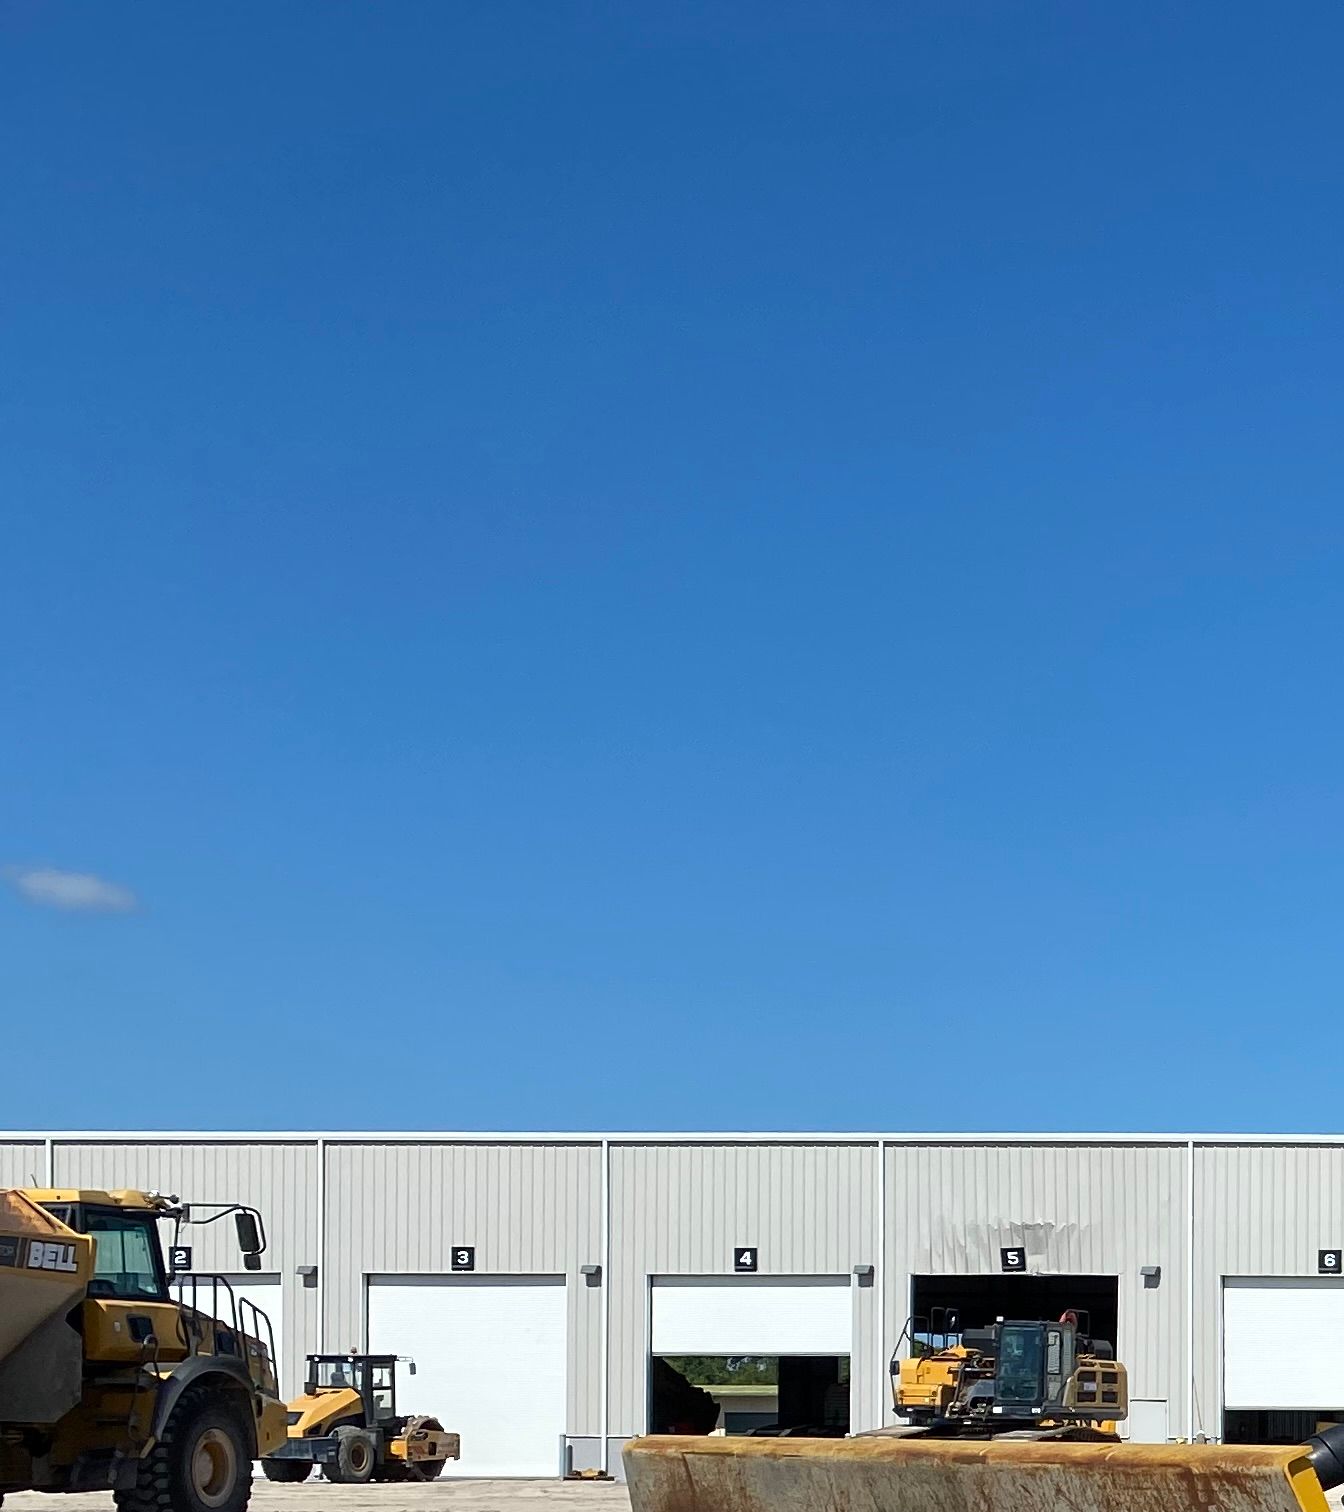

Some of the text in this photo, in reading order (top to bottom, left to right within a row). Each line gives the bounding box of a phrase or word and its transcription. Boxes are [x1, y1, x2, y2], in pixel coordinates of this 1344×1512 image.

[28, 1241, 78, 1271] BELL
[175, 1250, 187, 1264] 2
[457, 1250, 469, 1264] 3
[739, 1251, 752, 1266] 4
[1006, 1251, 1019, 1265] 5
[1324, 1253, 1336, 1267] 6
